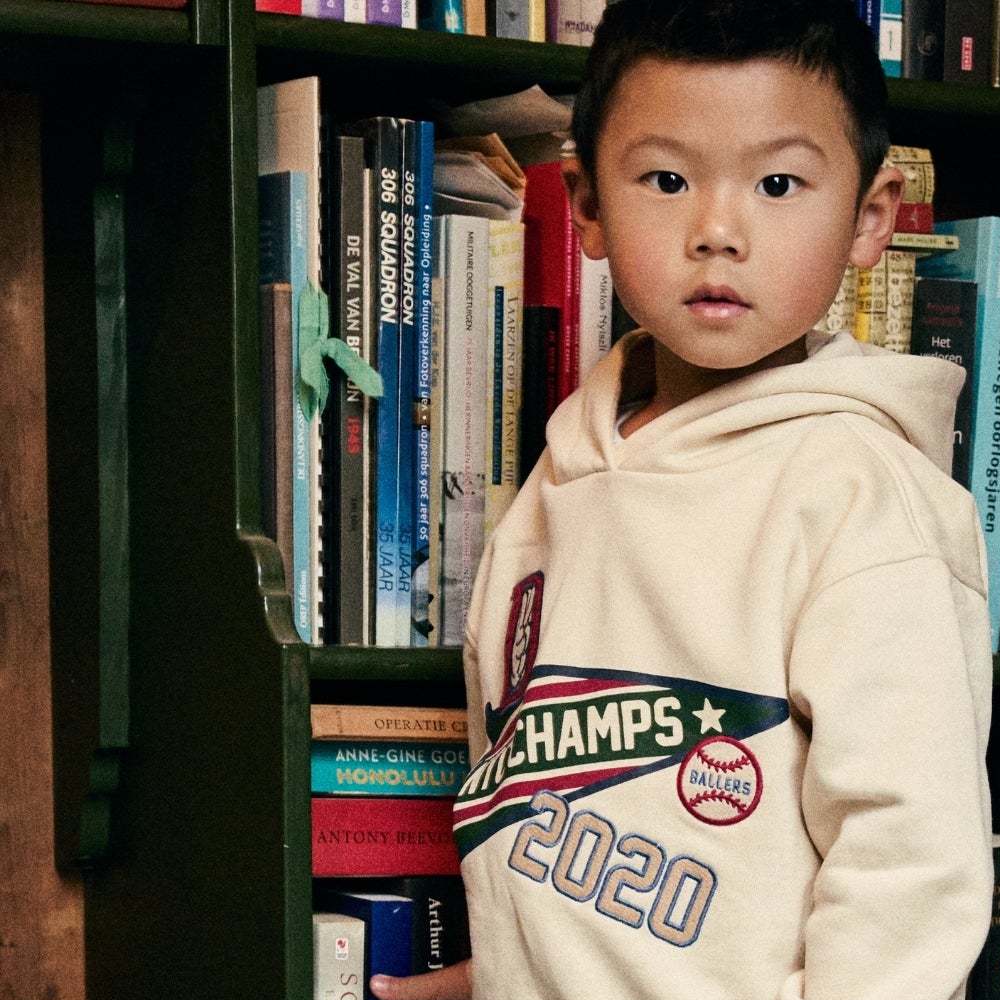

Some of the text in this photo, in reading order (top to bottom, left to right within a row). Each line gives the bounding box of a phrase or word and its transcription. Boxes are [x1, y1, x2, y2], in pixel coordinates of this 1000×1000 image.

[380, 168, 396, 323] 306 SQUADRON
[403, 171, 414, 325] 306 SQUADRON
[465, 231, 474, 331] MILITAIRE OOGGETUIGEN
[347, 236, 360, 402] DE VAL VAN BEIJN
[931, 337, 951, 348] Het
[418, 214, 432, 526] jaar 306 squadron van Fotoverkenning naar Opleiding
[374, 719, 450, 731] OPERATIE
[336, 749, 425, 763] ANNE-GINE
[336, 768, 454, 786] HONOLULU
[689, 769, 751, 796] BALLERS
[318, 831, 389, 844] ANTONY
[507, 789, 719, 949] 2020
[427, 898, 443, 958] Arthur
